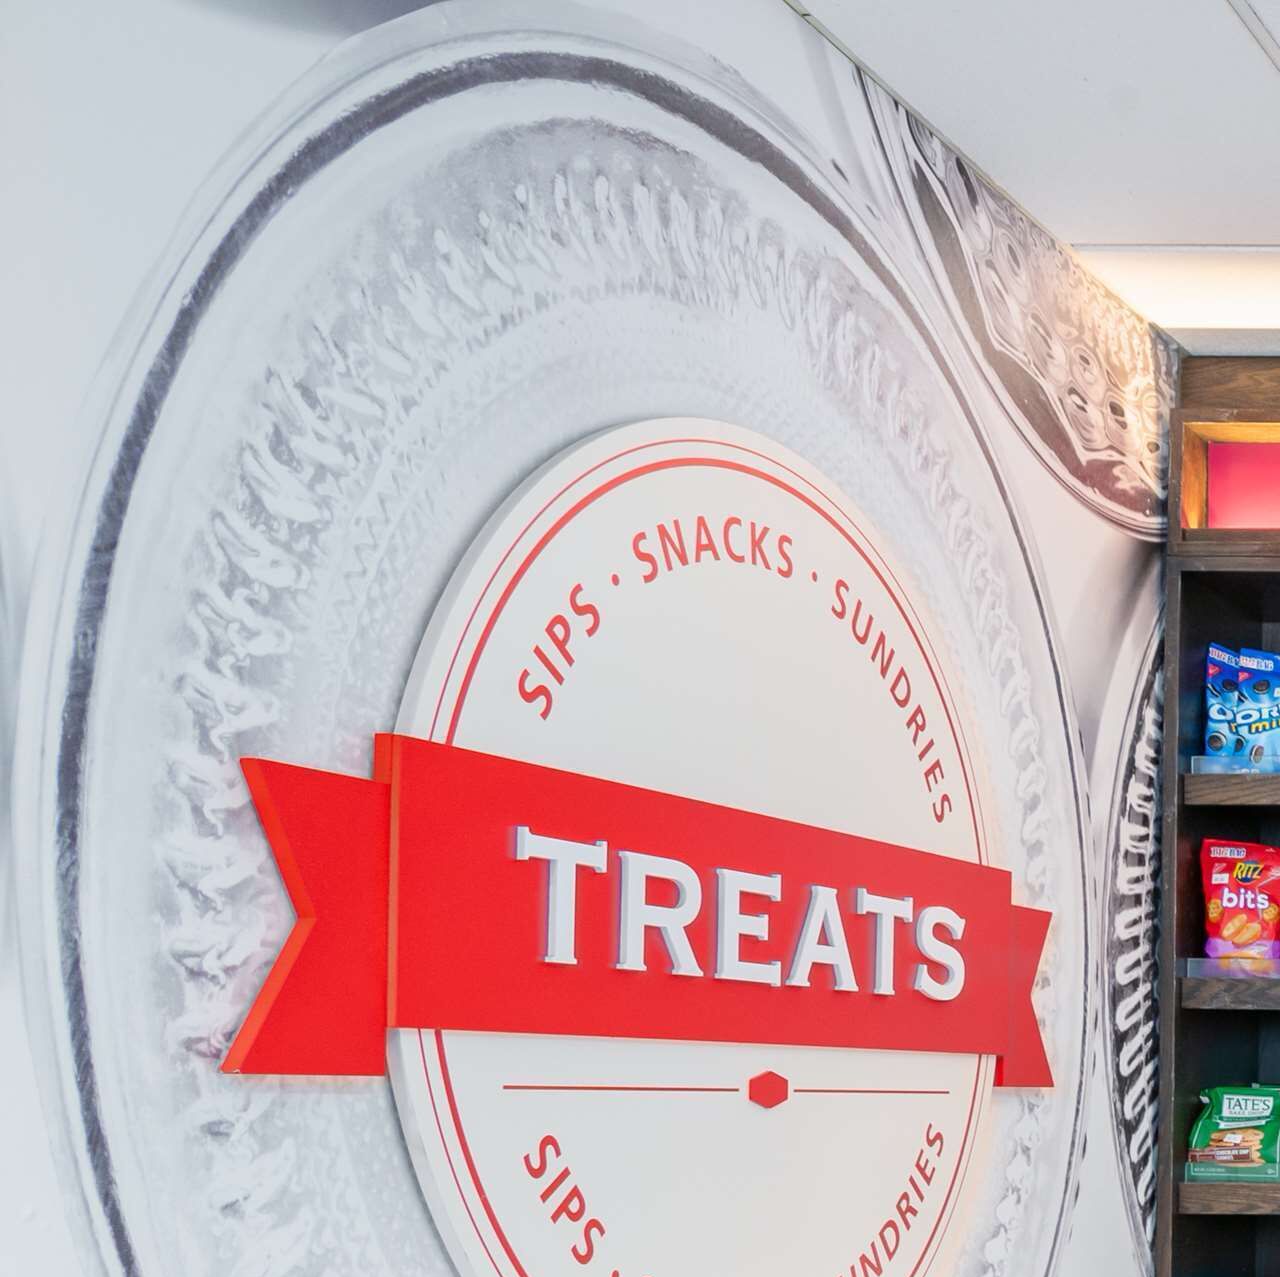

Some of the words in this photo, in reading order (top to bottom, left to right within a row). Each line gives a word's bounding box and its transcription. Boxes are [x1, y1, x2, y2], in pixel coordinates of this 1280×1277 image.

[517, 582, 601, 720] SIPS
[631, 516, 794, 583] SNACKS
[831, 580, 953, 825] SUNDRIES
[1222, 887, 1269, 910] bits
[1233, 862, 1264, 880] RITZ
[516, 825, 968, 1002] TREATS
[1225, 1097, 1271, 1112] TATE'S
[523, 1134, 607, 1267] SIPS
